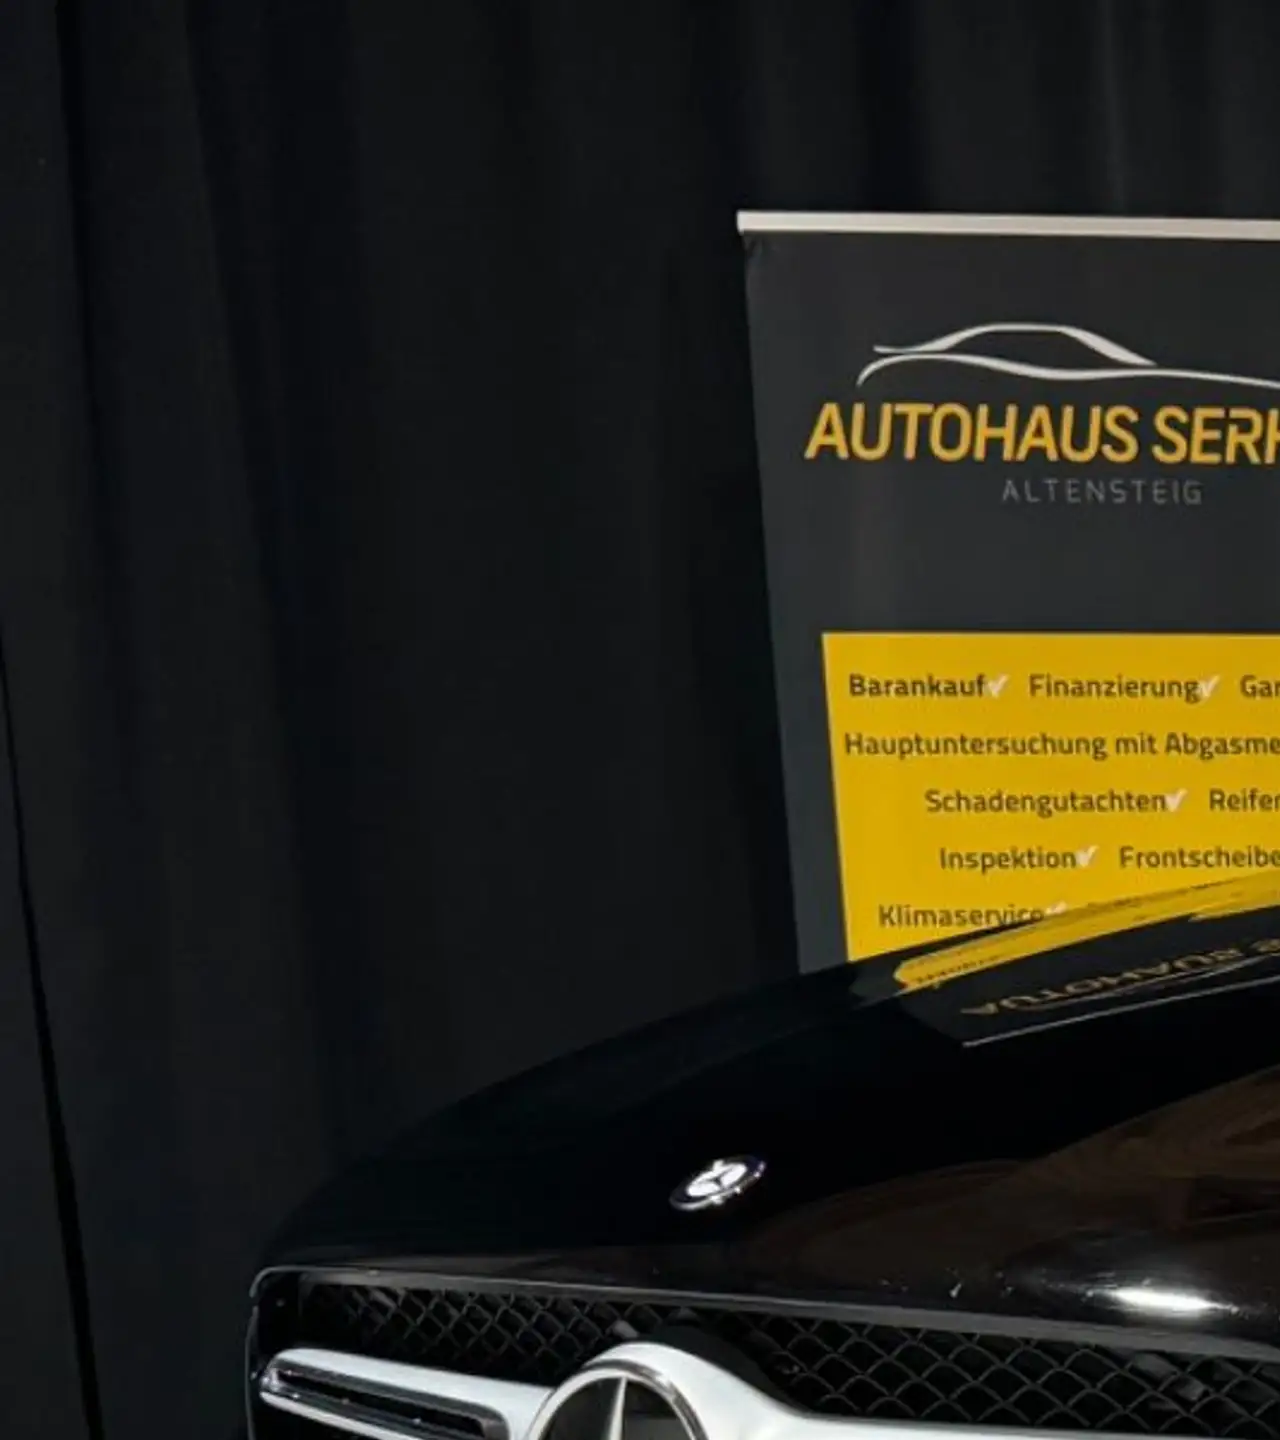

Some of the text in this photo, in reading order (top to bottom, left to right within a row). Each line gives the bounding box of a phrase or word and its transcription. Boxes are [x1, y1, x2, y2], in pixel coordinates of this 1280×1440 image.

[805, 403, 1138, 463] AUTOHAUS
[1002, 478, 1203, 505] ALTENSTEIG
[849, 674, 986, 698] Barankauf
[1029, 674, 1200, 704] Finanzierung
[844, 732, 1108, 762] Hauptuntersuchung
[1115, 732, 1157, 755] mit
[924, 788, 1167, 818] Schadengutachten
[939, 847, 1077, 875] Inspektion
